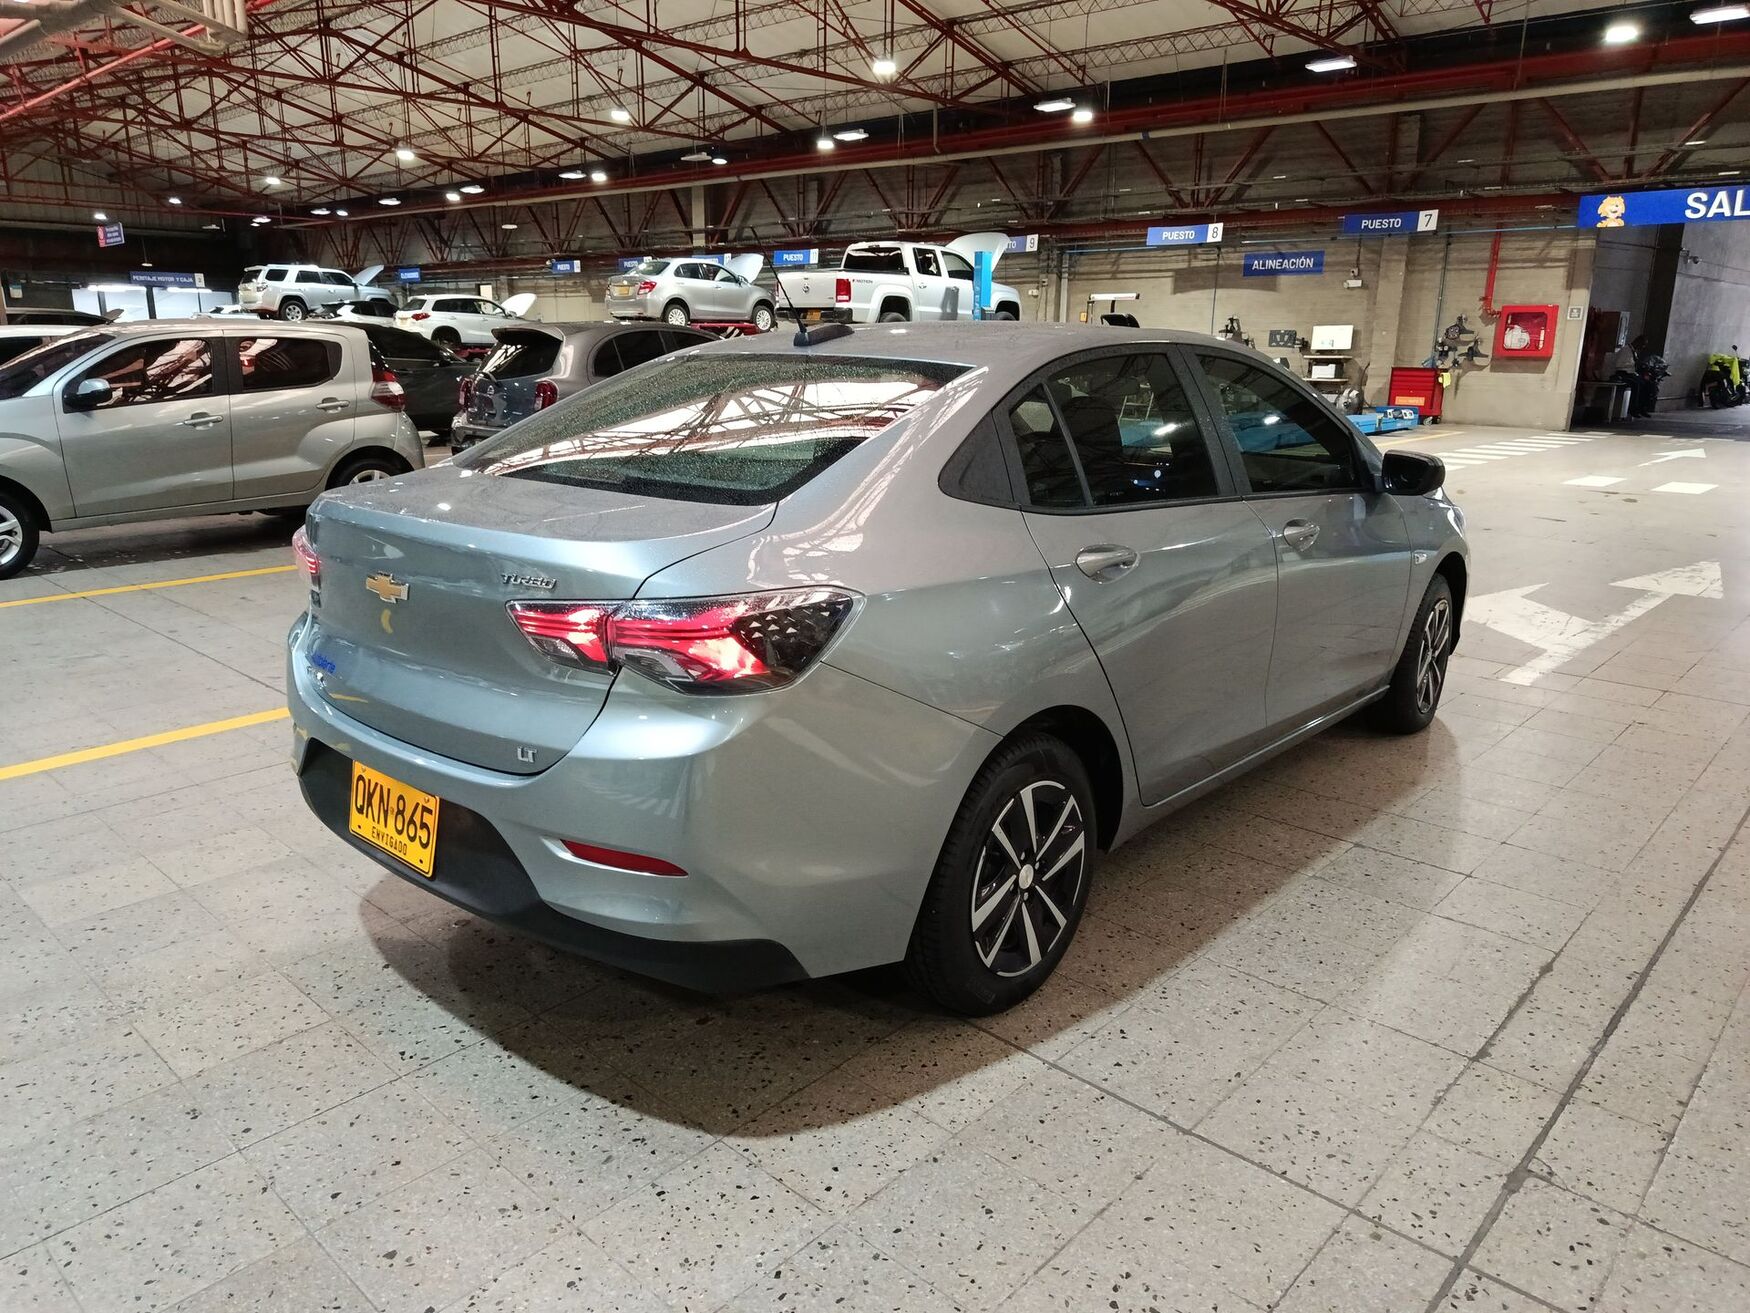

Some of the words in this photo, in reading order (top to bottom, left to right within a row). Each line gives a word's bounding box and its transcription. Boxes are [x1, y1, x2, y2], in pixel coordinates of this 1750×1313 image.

[1361, 217, 1402, 230] PUESTO
[1424, 213, 1433, 228] 7
[1162, 230, 1195, 241] PUESTO
[1211, 226, 1219, 239] 8
[1029, 237, 1036, 249] 9
[783, 253, 804, 262] PUESTO
[1251, 256, 1314, 271] ALINEACIÓN
[501, 573, 557, 590] TURBO
[517, 744, 539, 763] LT
[354, 774, 391, 829] QKN
[394, 794, 433, 850] 865
[371, 826, 408, 856] ENVIGADO
